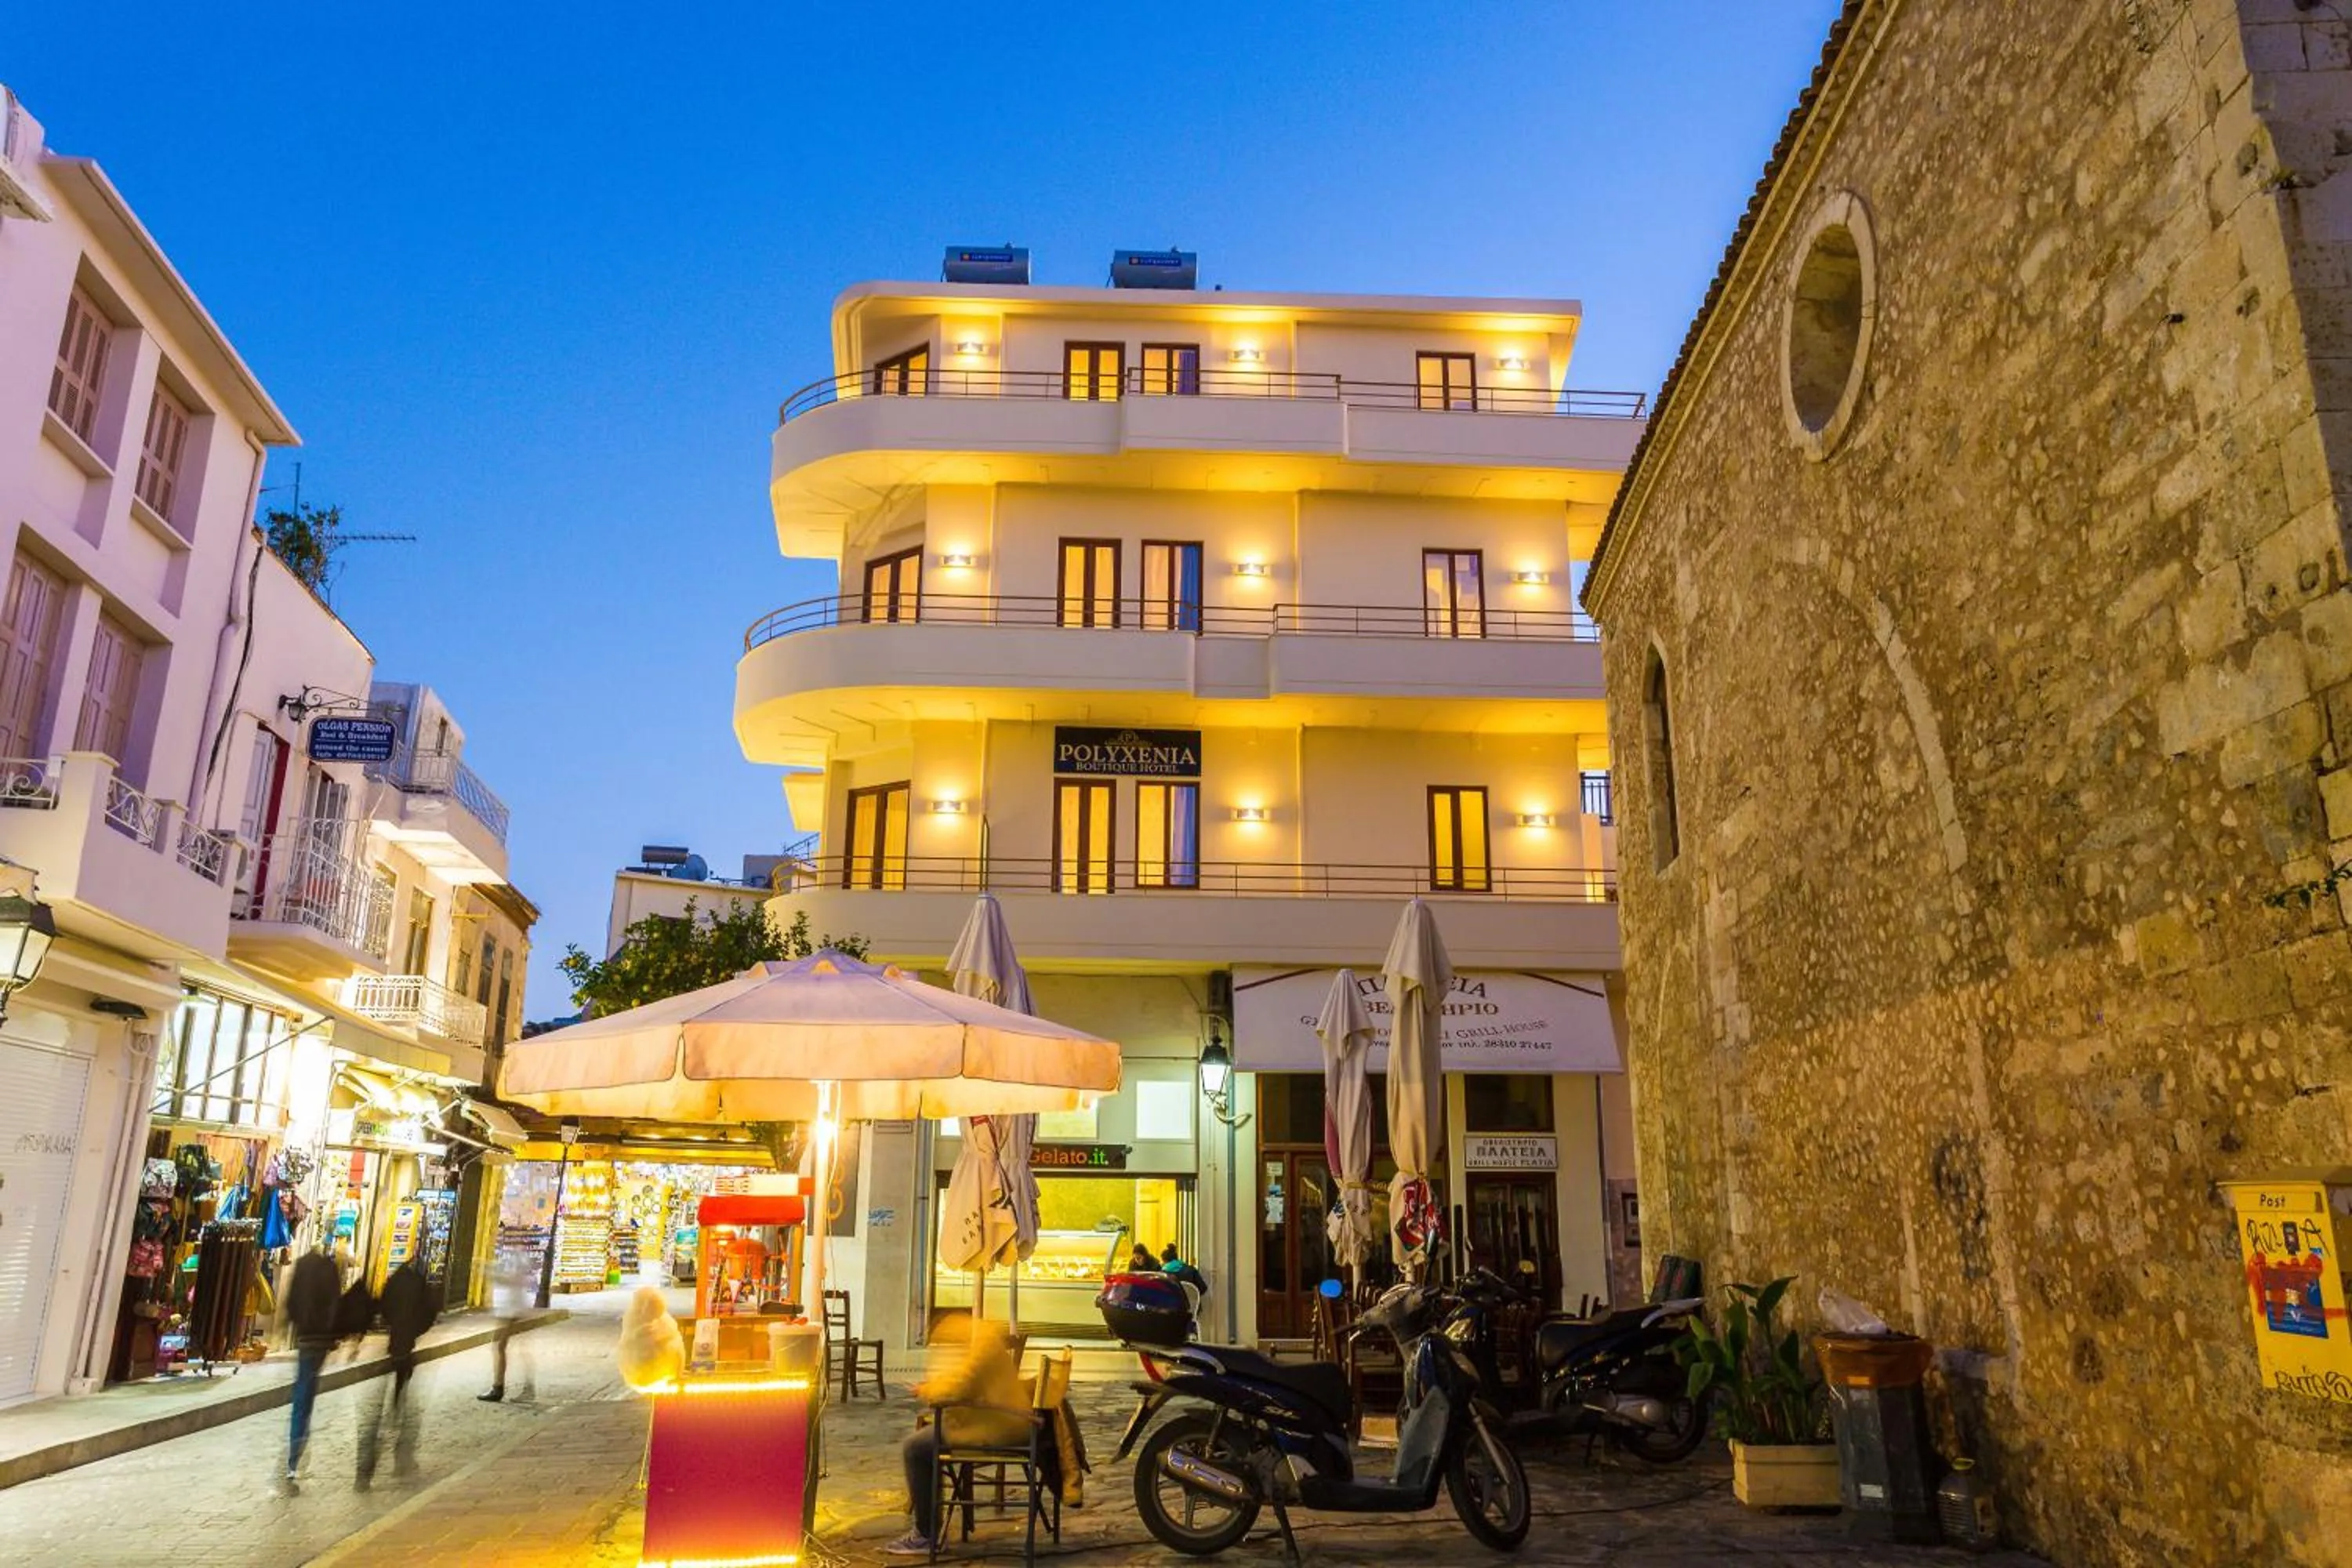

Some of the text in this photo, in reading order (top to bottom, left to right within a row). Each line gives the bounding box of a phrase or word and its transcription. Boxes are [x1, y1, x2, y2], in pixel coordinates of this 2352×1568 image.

[318, 721, 391, 733] OLGAS PENSION
[1060, 744, 1197, 765] POLYXENIA
[1076, 761, 1180, 773] BOUTIQUE HOTEL
[1455, 1025, 1503, 1039] GRILL
[2259, 1192, 2286, 1207] Post
